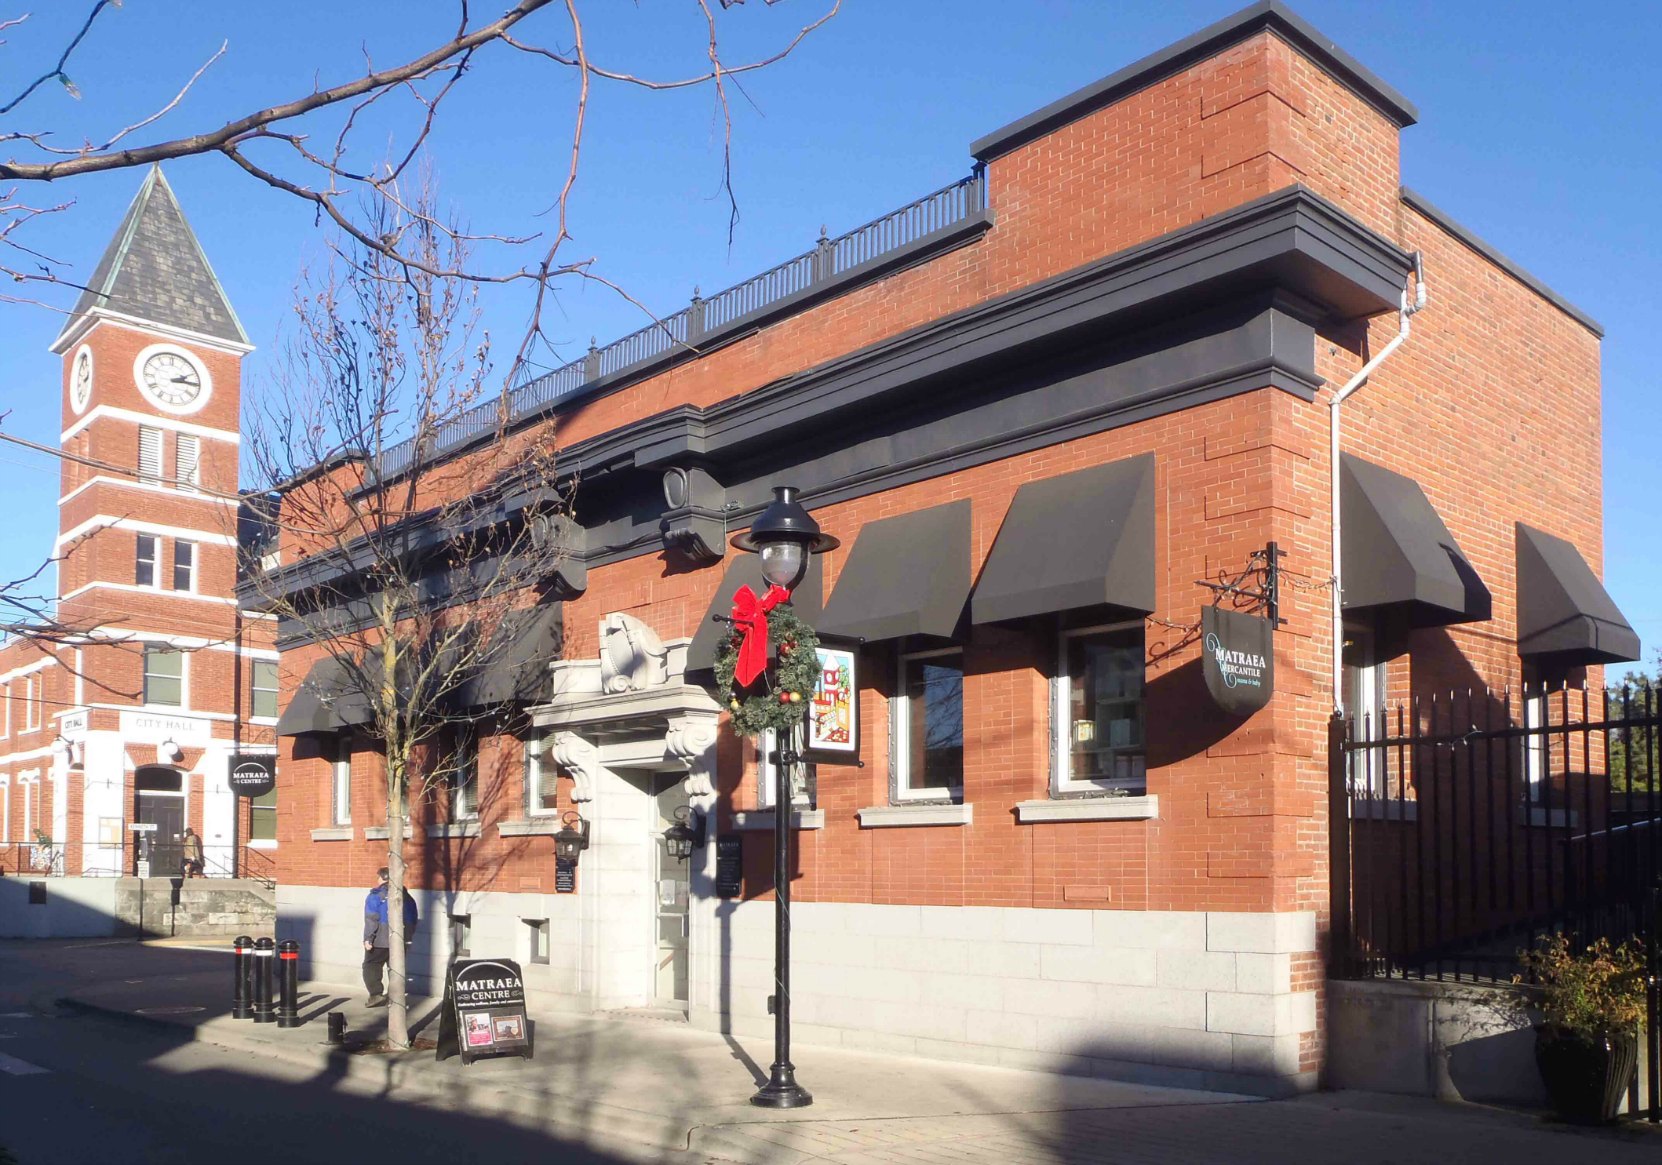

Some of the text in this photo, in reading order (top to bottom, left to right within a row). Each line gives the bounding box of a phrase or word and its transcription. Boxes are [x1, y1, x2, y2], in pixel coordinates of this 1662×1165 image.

[1215, 648, 1266, 668] MATRAEA
[1221, 664, 1260, 677] MERCANTILE
[65, 718, 82, 729] CITY HALL
[136, 718, 195, 731] CITY HALL
[456, 978, 522, 991] MATRAEA
[472, 990, 510, 1000] CENTRE
